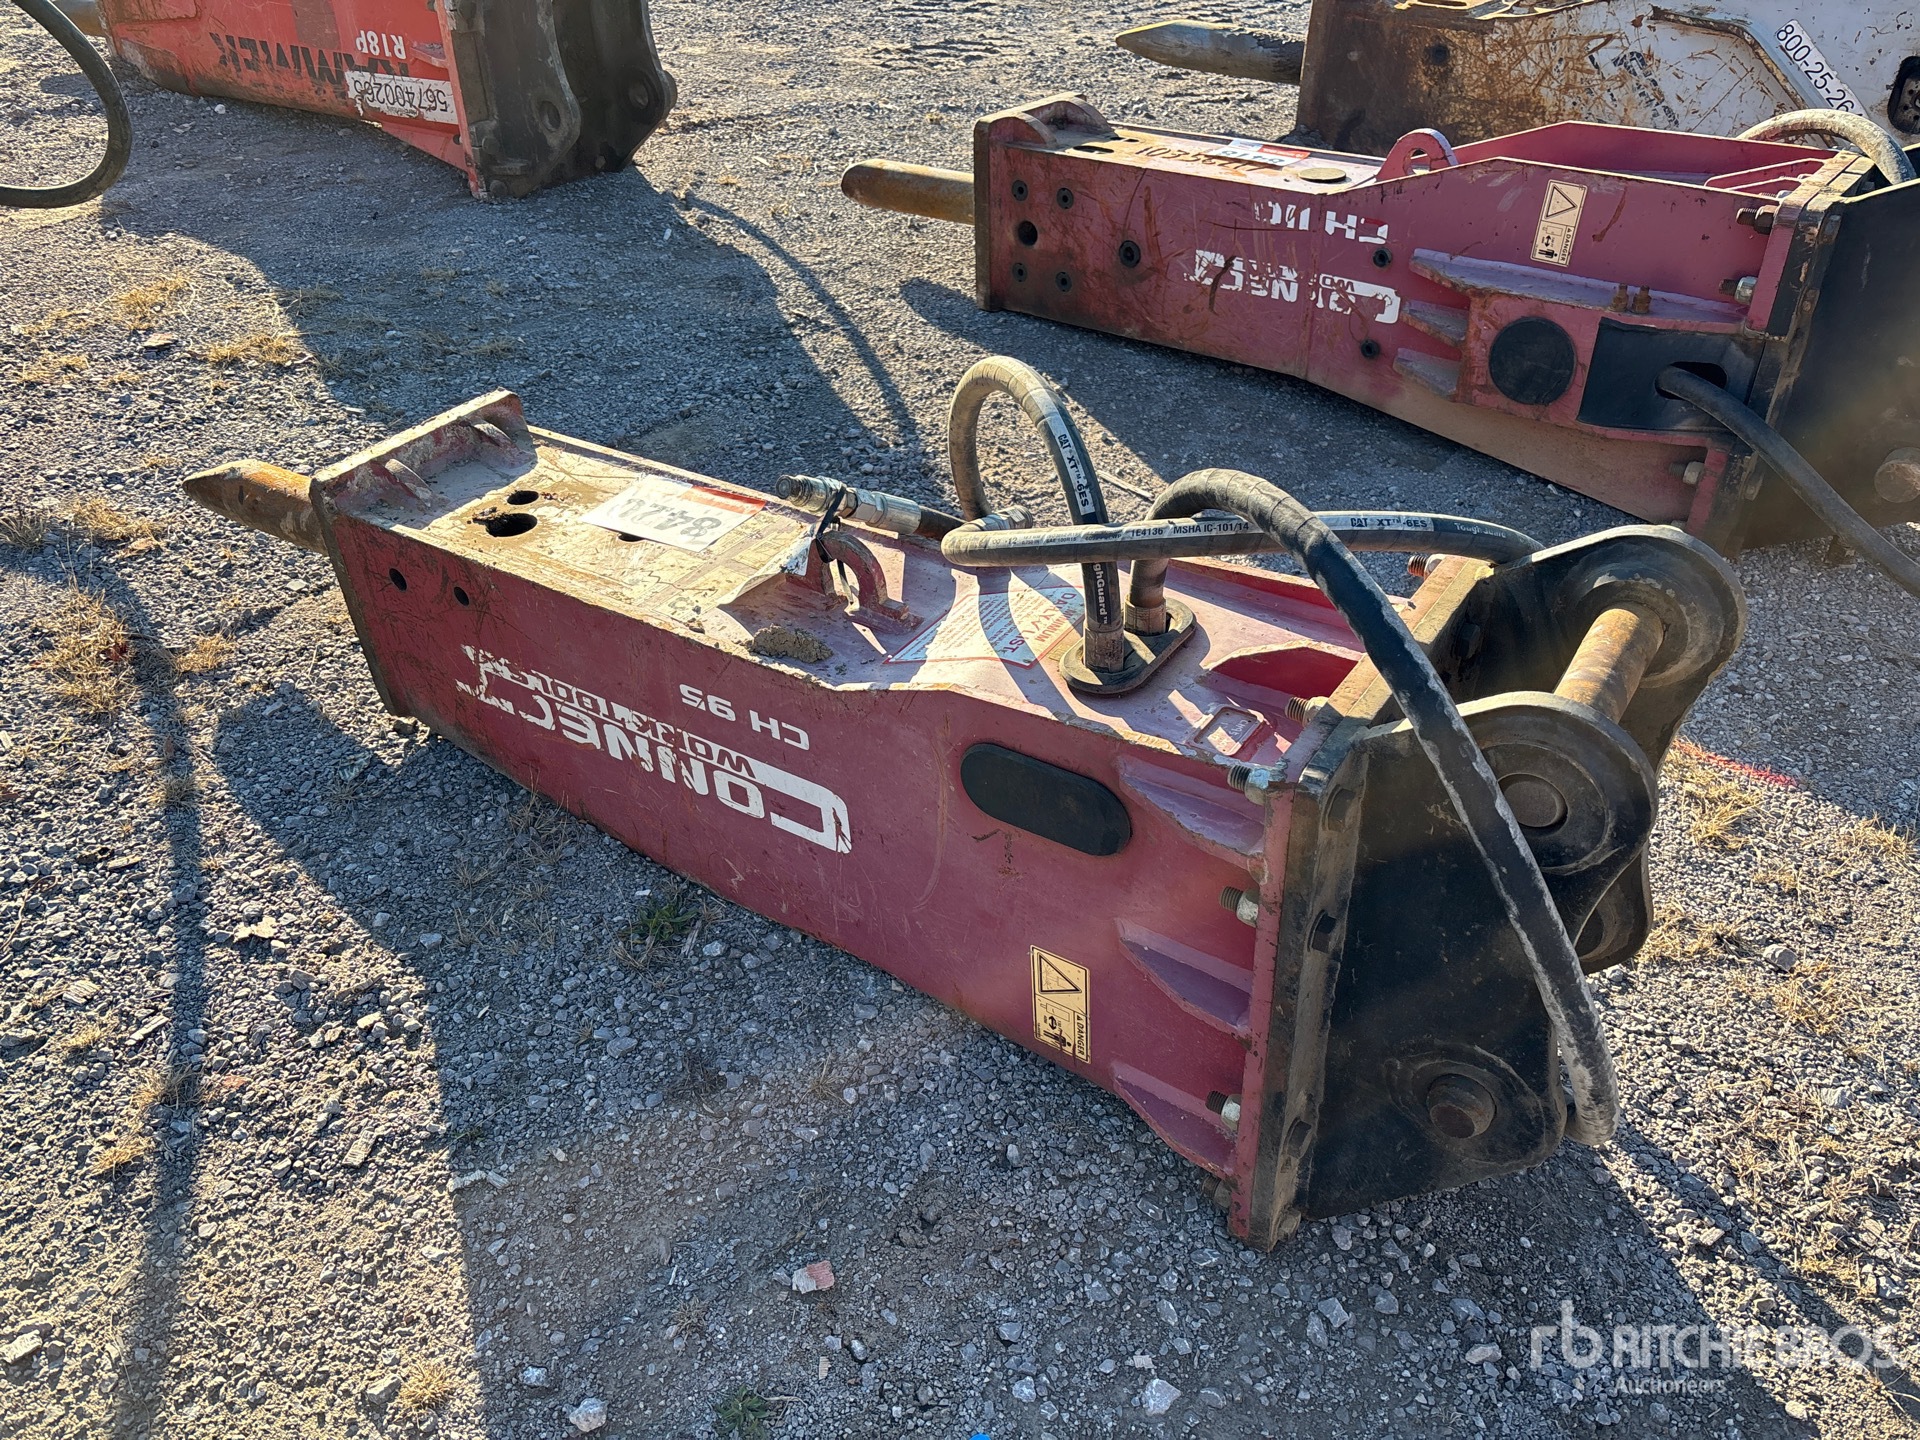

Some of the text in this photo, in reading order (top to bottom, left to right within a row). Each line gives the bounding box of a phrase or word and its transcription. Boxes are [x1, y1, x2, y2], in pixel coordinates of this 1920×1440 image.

[355, 29, 406, 60] R18P
[1777, 24, 1863, 117] 800-25-26
[1325, 210, 1388, 244] CH
[1560, 234, 1572, 262] DANGER
[1057, 433, 1073, 450] CAT
[1131, 526, 1164, 538] 1E4136
[1173, 523, 1200, 535] MSHA
[1203, 521, 1249, 533] IC-101/14
[1350, 517, 1369, 528] CAT
[1035, 608, 1077, 643] MINIMUM
[679, 683, 812, 751] CH 95
[456, 645, 852, 855] CONNECT
[1075, 1023, 1086, 1056] DANGER
